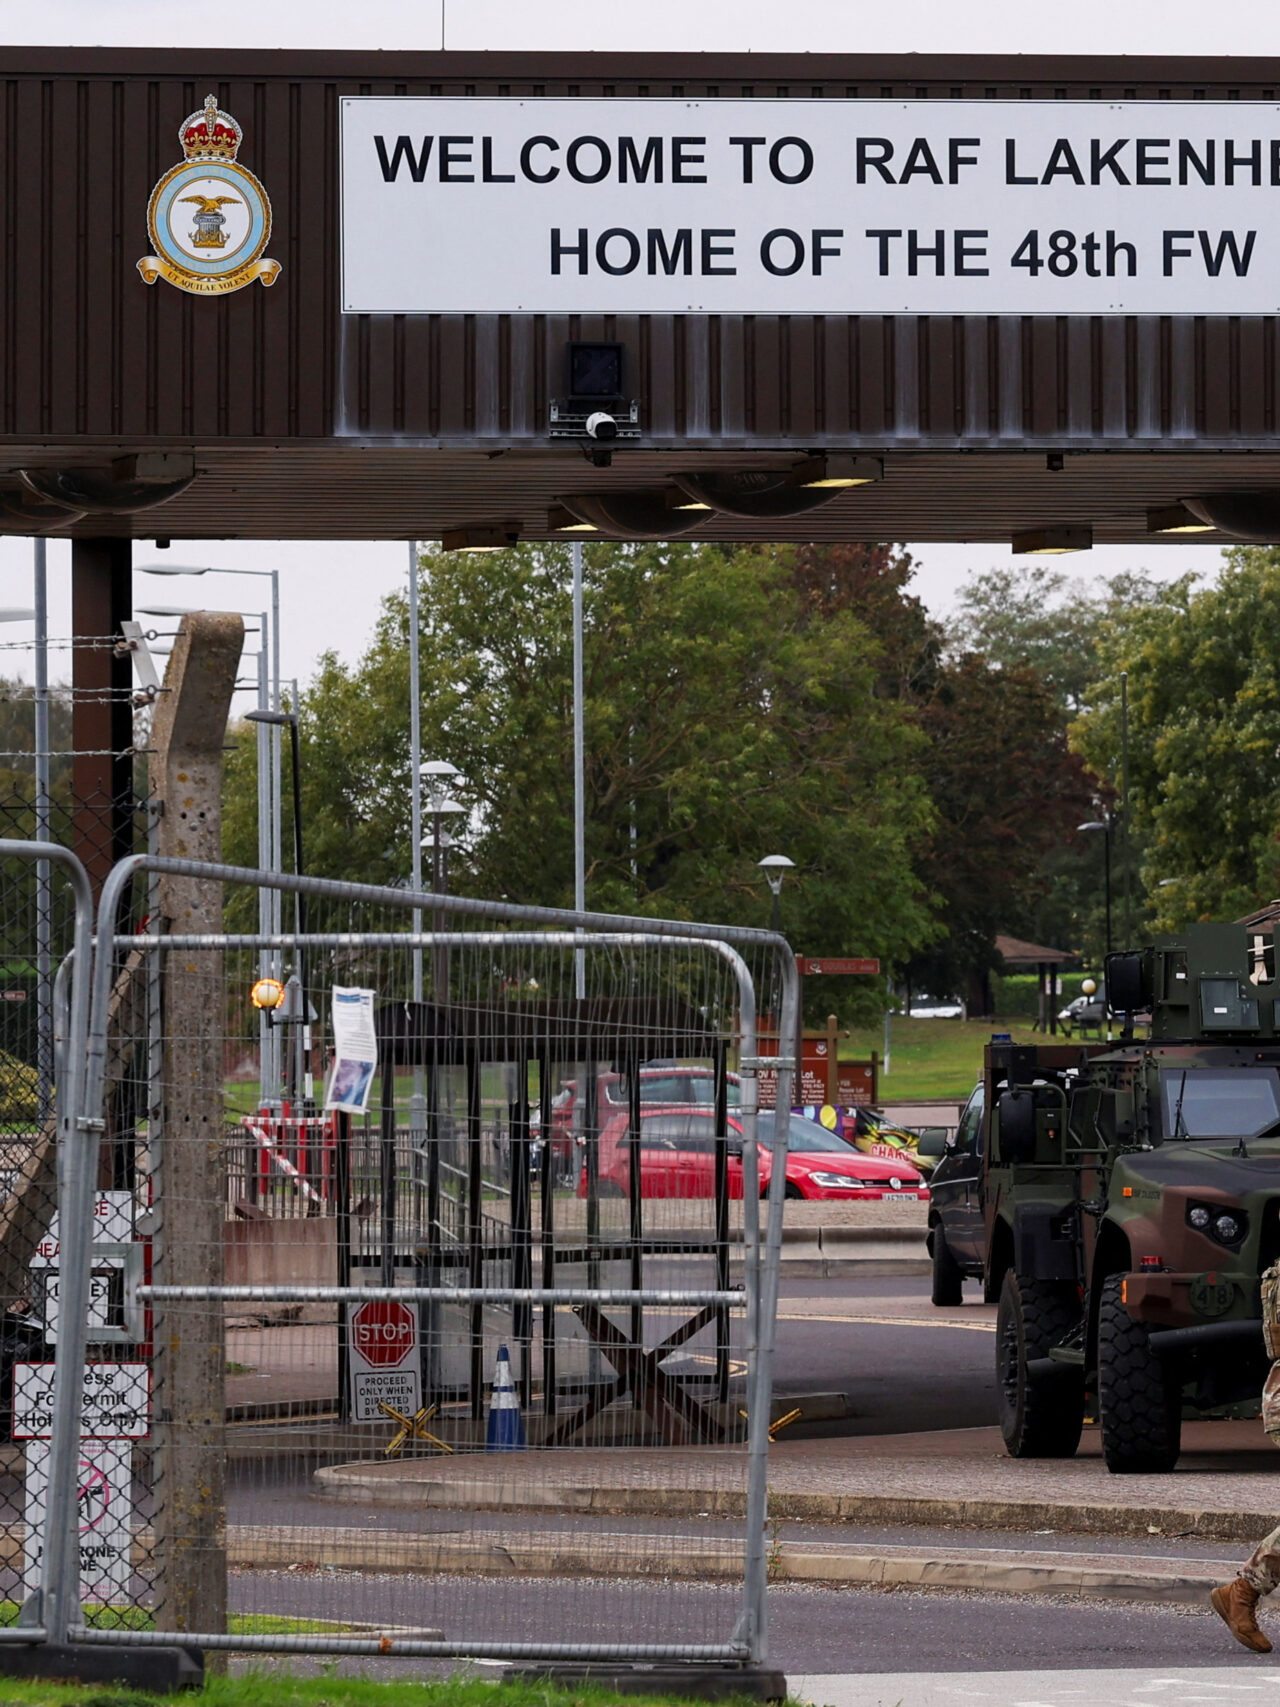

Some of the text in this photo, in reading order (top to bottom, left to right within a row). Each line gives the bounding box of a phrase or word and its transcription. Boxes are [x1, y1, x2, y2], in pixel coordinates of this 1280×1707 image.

[374, 136, 707, 184] WELCOME
[730, 137, 813, 184] TO
[857, 138, 980, 185] RAF
[551, 228, 1256, 277] HOME OF THE 48th FW
[360, 1322, 409, 1341] STOP
[365, 1377, 407, 1385] PROCEED
[360, 1386, 413, 1396] ONLY WHEN
[365, 1396, 409, 1405] DIRECTED
